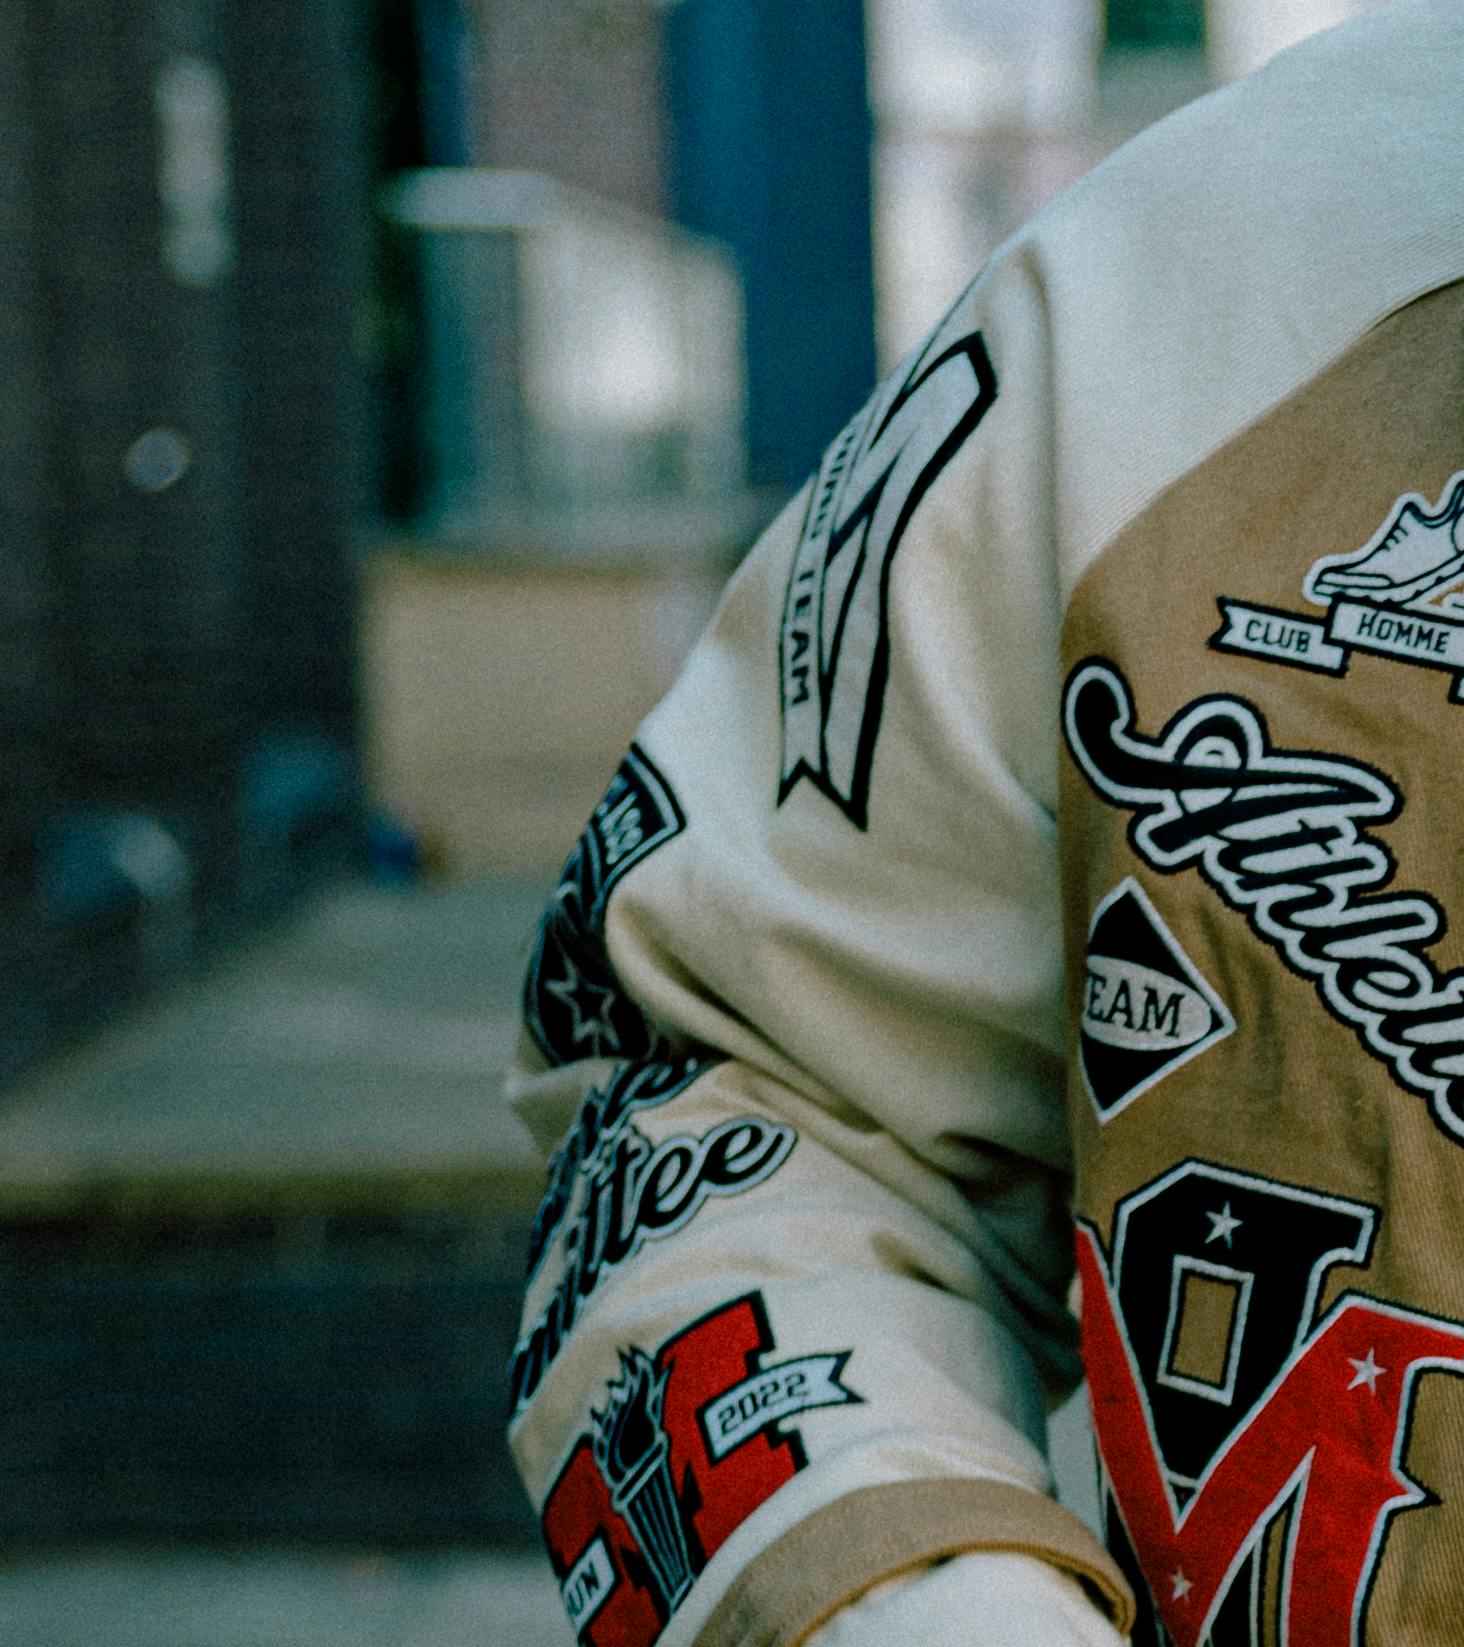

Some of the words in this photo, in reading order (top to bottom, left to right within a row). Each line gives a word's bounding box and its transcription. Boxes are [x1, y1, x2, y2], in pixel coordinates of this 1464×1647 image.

[1244, 617, 1311, 654] CLUB
[1356, 612, 1451, 654] HOMME
[1086, 971, 1186, 1039] EAM
[717, 1372, 811, 1437] 2022
[566, 1559, 601, 1617] UN
